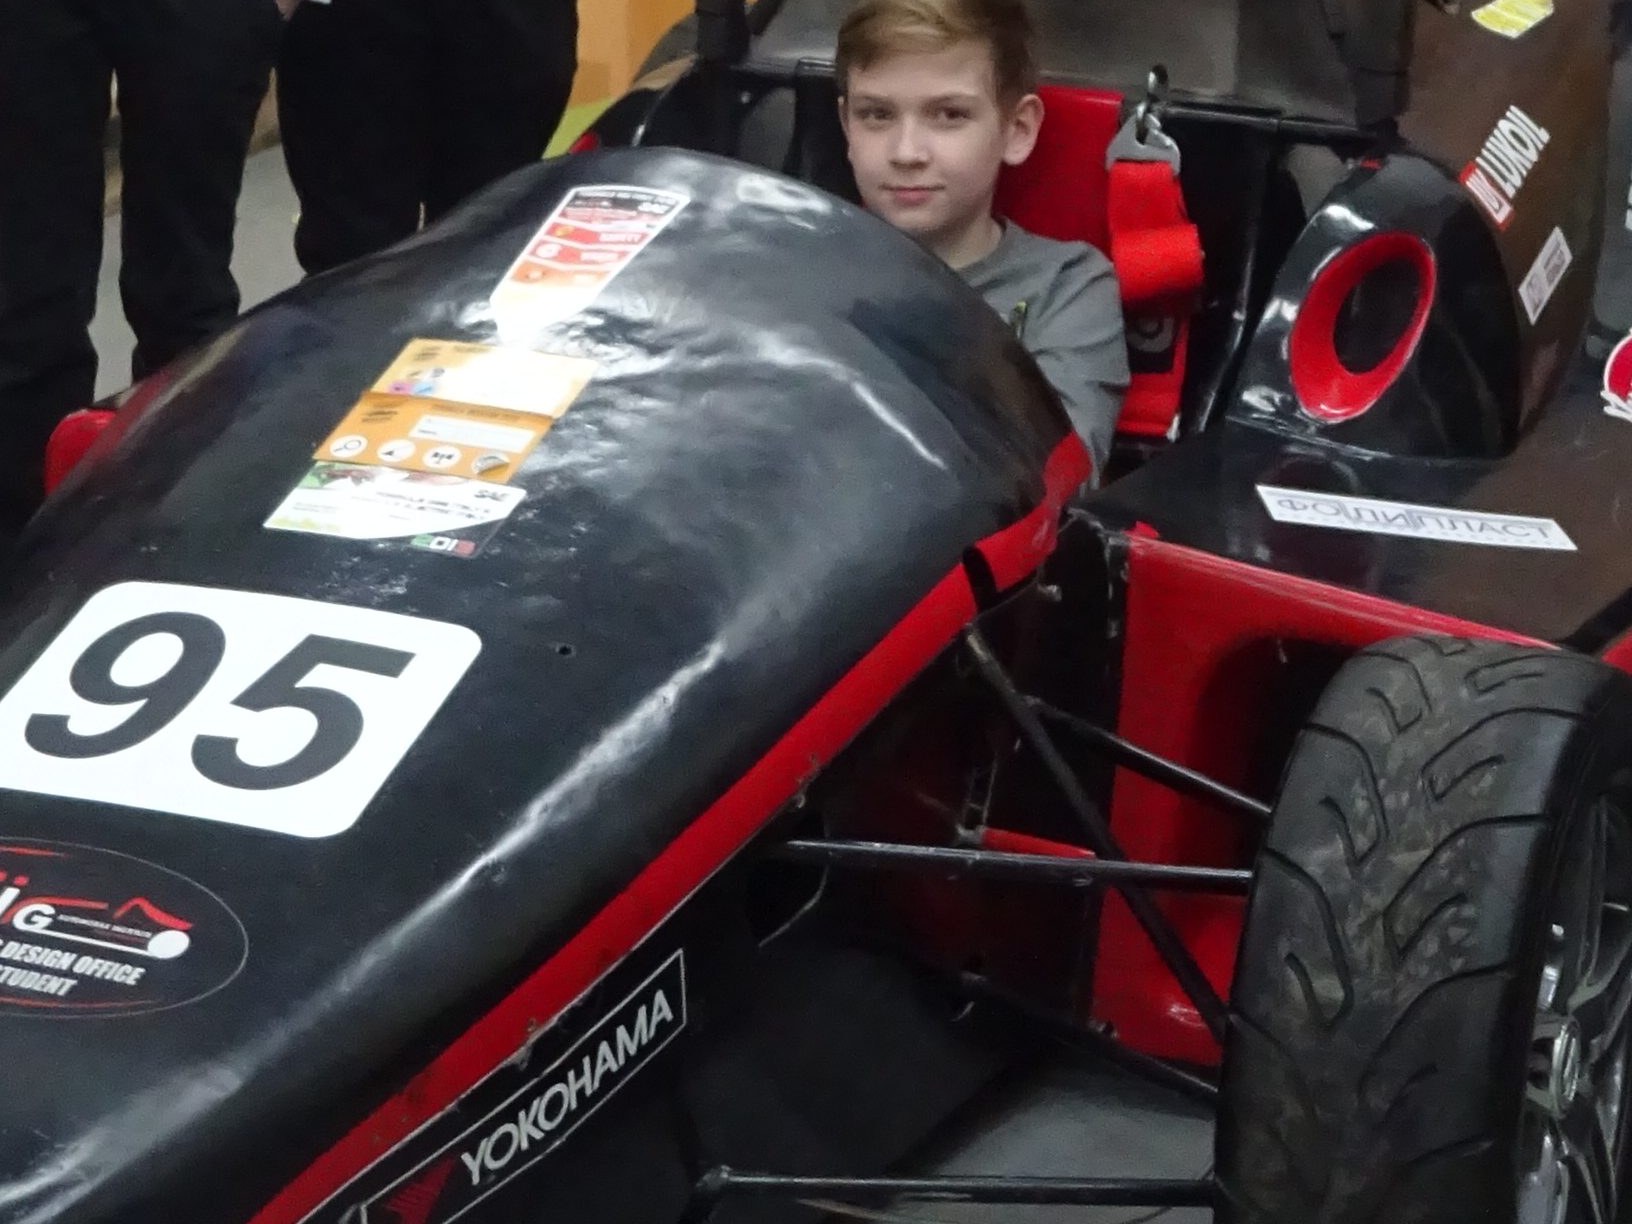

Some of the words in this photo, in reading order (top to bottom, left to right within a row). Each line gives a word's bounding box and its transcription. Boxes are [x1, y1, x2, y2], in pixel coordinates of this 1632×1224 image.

[1475, 104, 1551, 199] LUKOIL
[24, 610, 417, 791] 95
[0, 940, 77, 971] DESIGN
[72, 955, 146, 986] OFFICE
[460, 988, 674, 1187] YOKOHAMA
